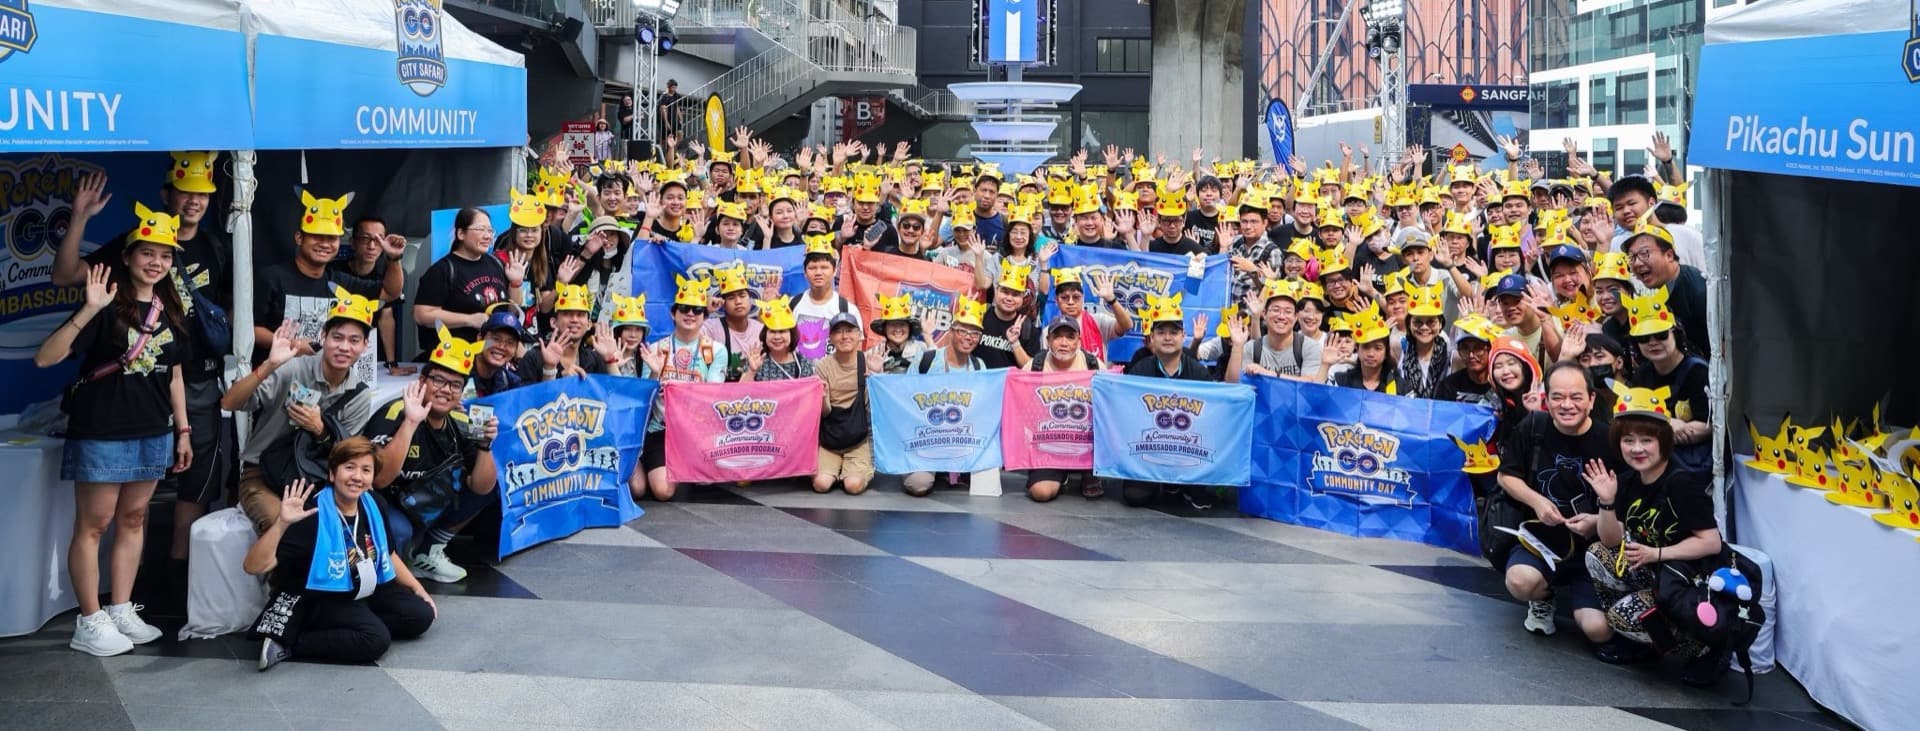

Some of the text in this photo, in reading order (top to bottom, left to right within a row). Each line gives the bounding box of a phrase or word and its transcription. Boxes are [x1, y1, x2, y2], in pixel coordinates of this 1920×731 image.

[401, 63, 444, 81] CITY SAFARI
[1481, 89, 1546, 101] SANGFAH
[356, 105, 478, 135] COMMUNITY
[1725, 114, 1915, 163] Pikachu Sun
[910, 437, 951, 449] AMBASSADOR
[1032, 433, 1074, 441] AMBASSADOR
[710, 446, 750, 458] AMBASSADOR
[1135, 442, 1178, 452] AMBASSADOR
[1324, 474, 1396, 495] COMMUNITY DAY
